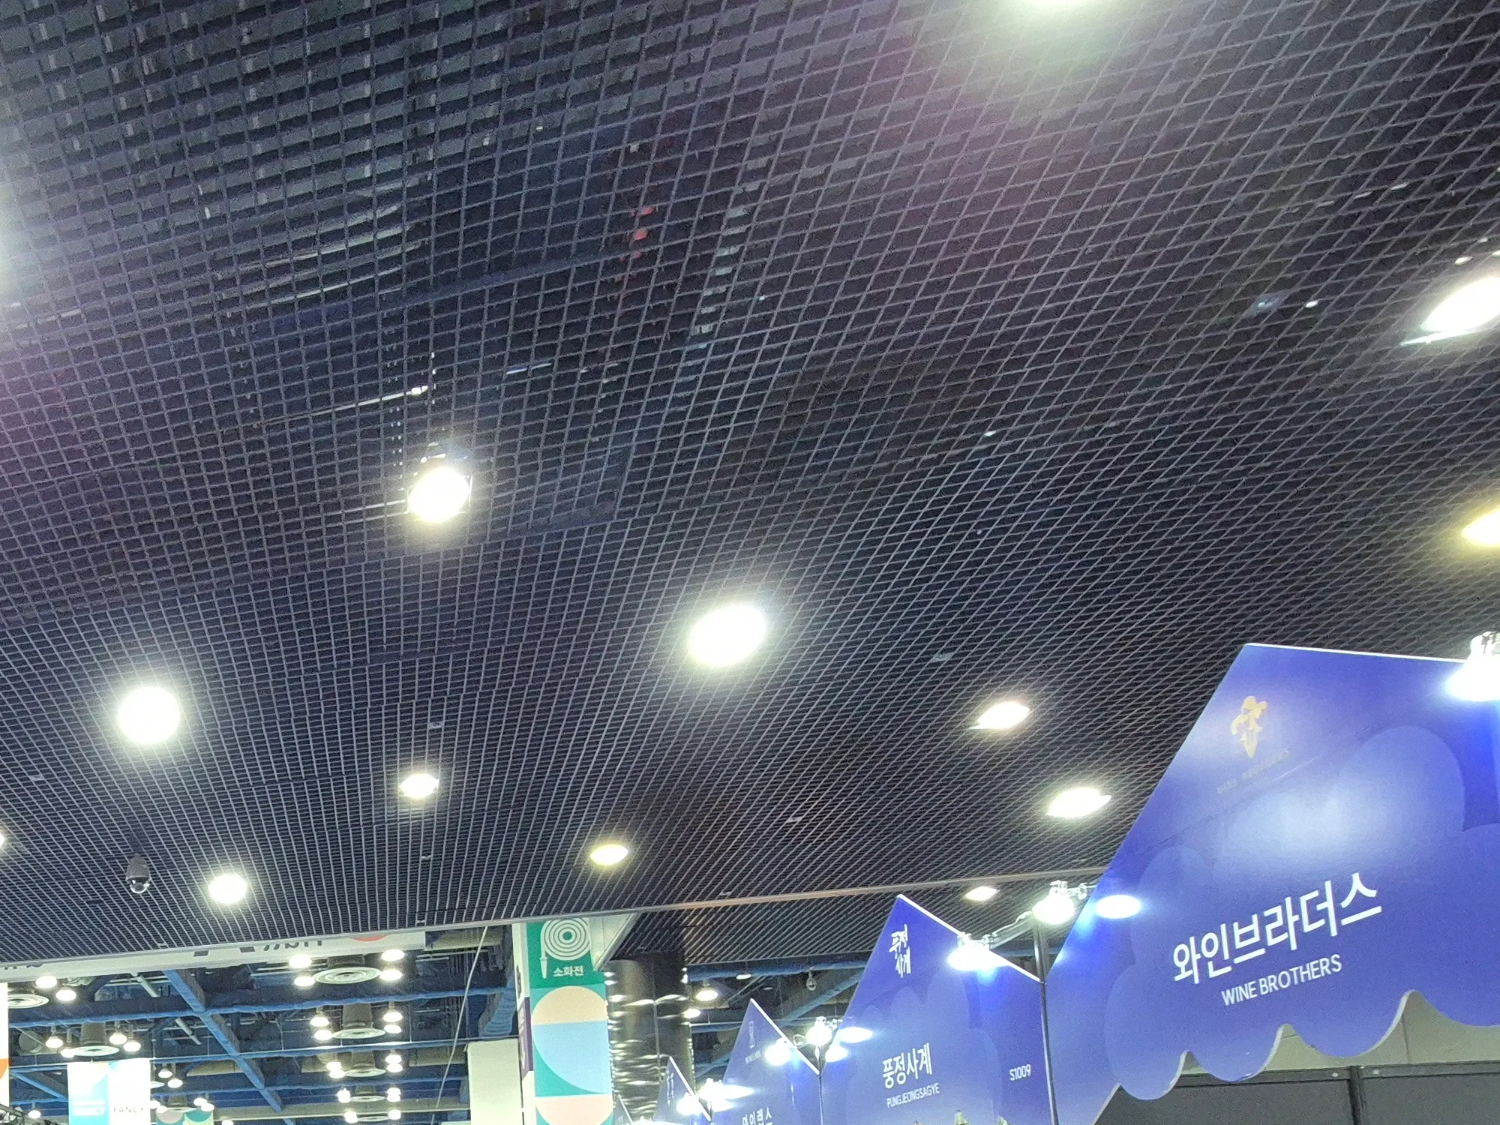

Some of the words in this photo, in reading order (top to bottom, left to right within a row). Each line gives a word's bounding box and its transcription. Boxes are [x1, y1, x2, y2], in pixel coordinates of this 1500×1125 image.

[1173, 872, 1383, 985] 와인브라더스
[553, 965, 584, 977] 소화전
[1220, 980, 1258, 1007] WINE
[1259, 953, 1343, 996] BROTHERS
[882, 1042, 933, 1089] 풍정사계
[1009, 1063, 1032, 1082] S1009
